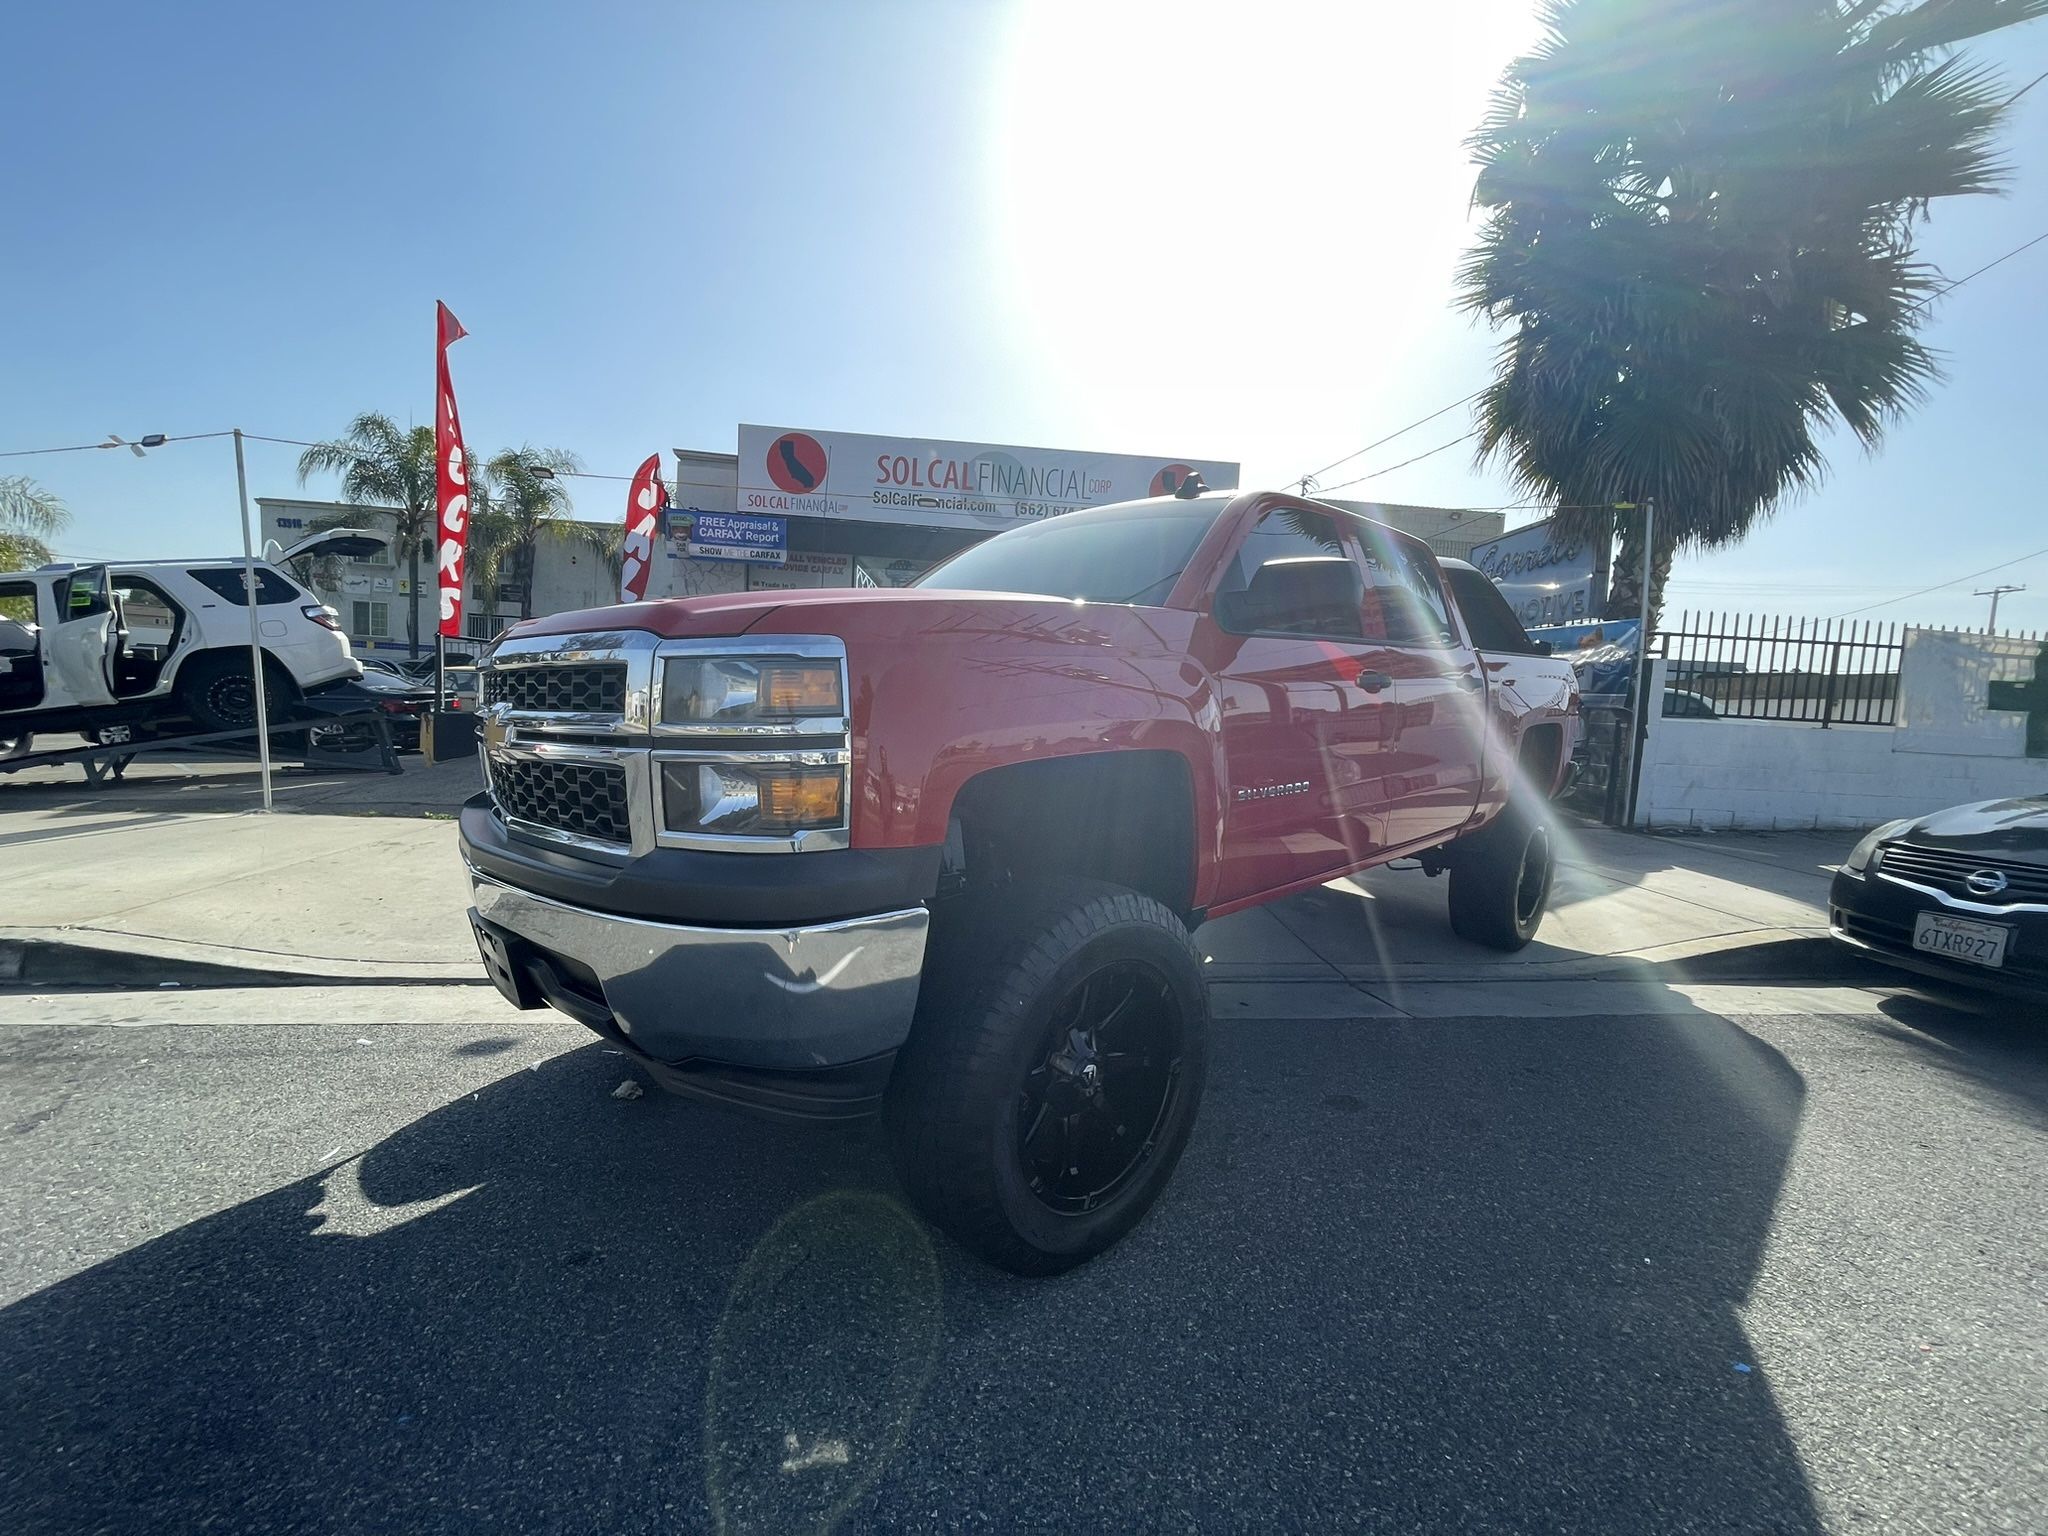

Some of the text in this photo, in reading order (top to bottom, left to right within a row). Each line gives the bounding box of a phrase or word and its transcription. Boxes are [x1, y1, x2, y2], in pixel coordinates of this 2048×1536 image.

[977, 462, 1092, 500] FINANCIAL
[1088, 477, 1112, 495] CORP
[1014, 501, 1049, 518] (562)
[699, 516, 726, 528] FREE
[727, 519, 771, 532] Appraisal
[772, 522, 779, 531] &
[699, 527, 779, 543] CARFAX Report
[699, 546, 722, 556] SHOW
[749, 550, 781, 560] CARFAX
[1918, 928, 1998, 960] 6TXR927
